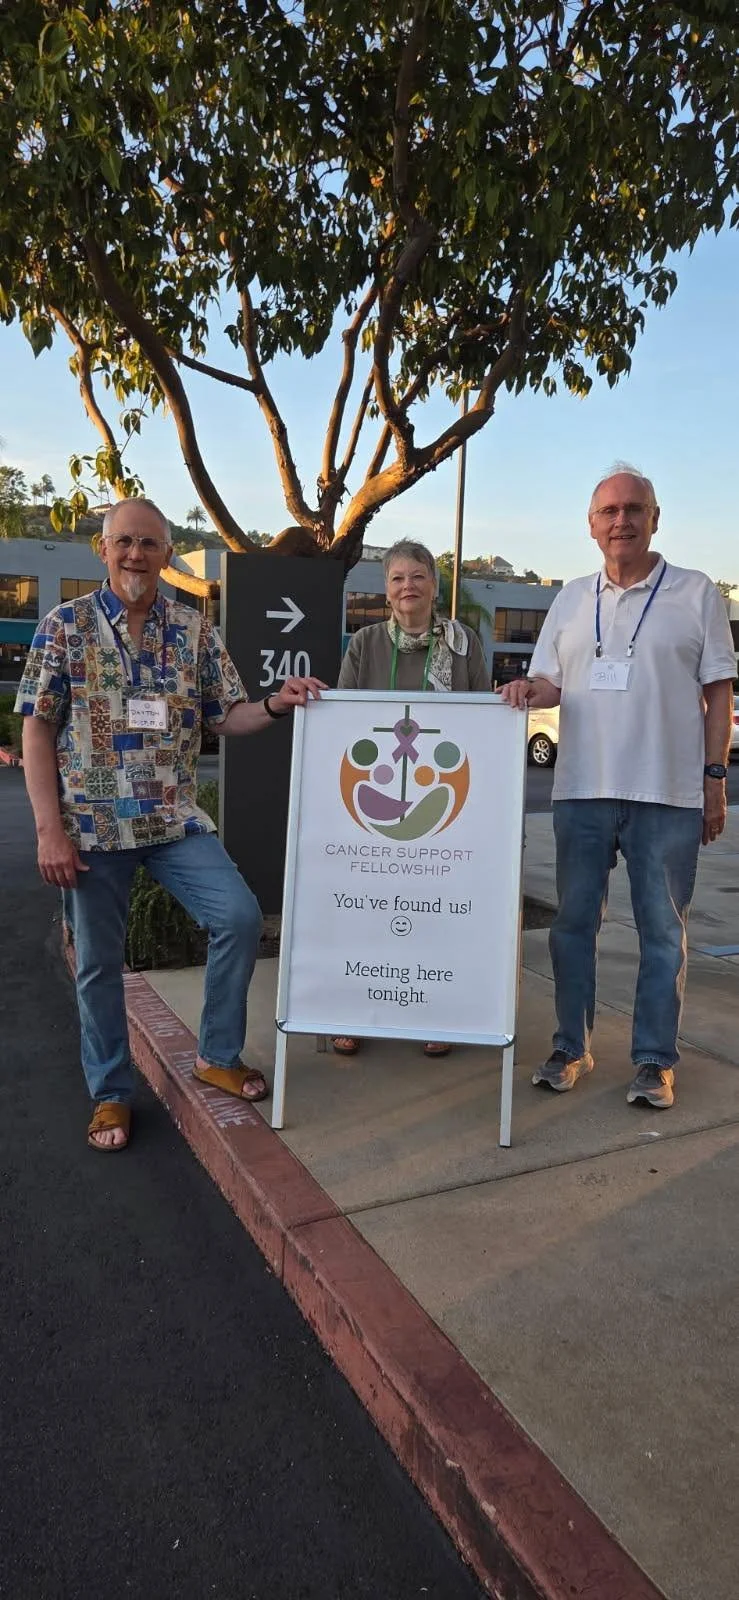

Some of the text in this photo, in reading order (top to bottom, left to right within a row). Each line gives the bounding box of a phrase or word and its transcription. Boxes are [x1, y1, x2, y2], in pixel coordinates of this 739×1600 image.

[259, 649, 311, 687] 340
[324, 843, 473, 862] CANCER SUPPORT
[349, 861, 451, 877] FELLOWSHIP
[333, 893, 472, 915] You've found us!
[345, 961, 453, 983] Meeting here
[367, 986, 428, 1007] tonight.
[127, 991, 185, 1037] PARKING
[196, 1087, 257, 1128] LANE
